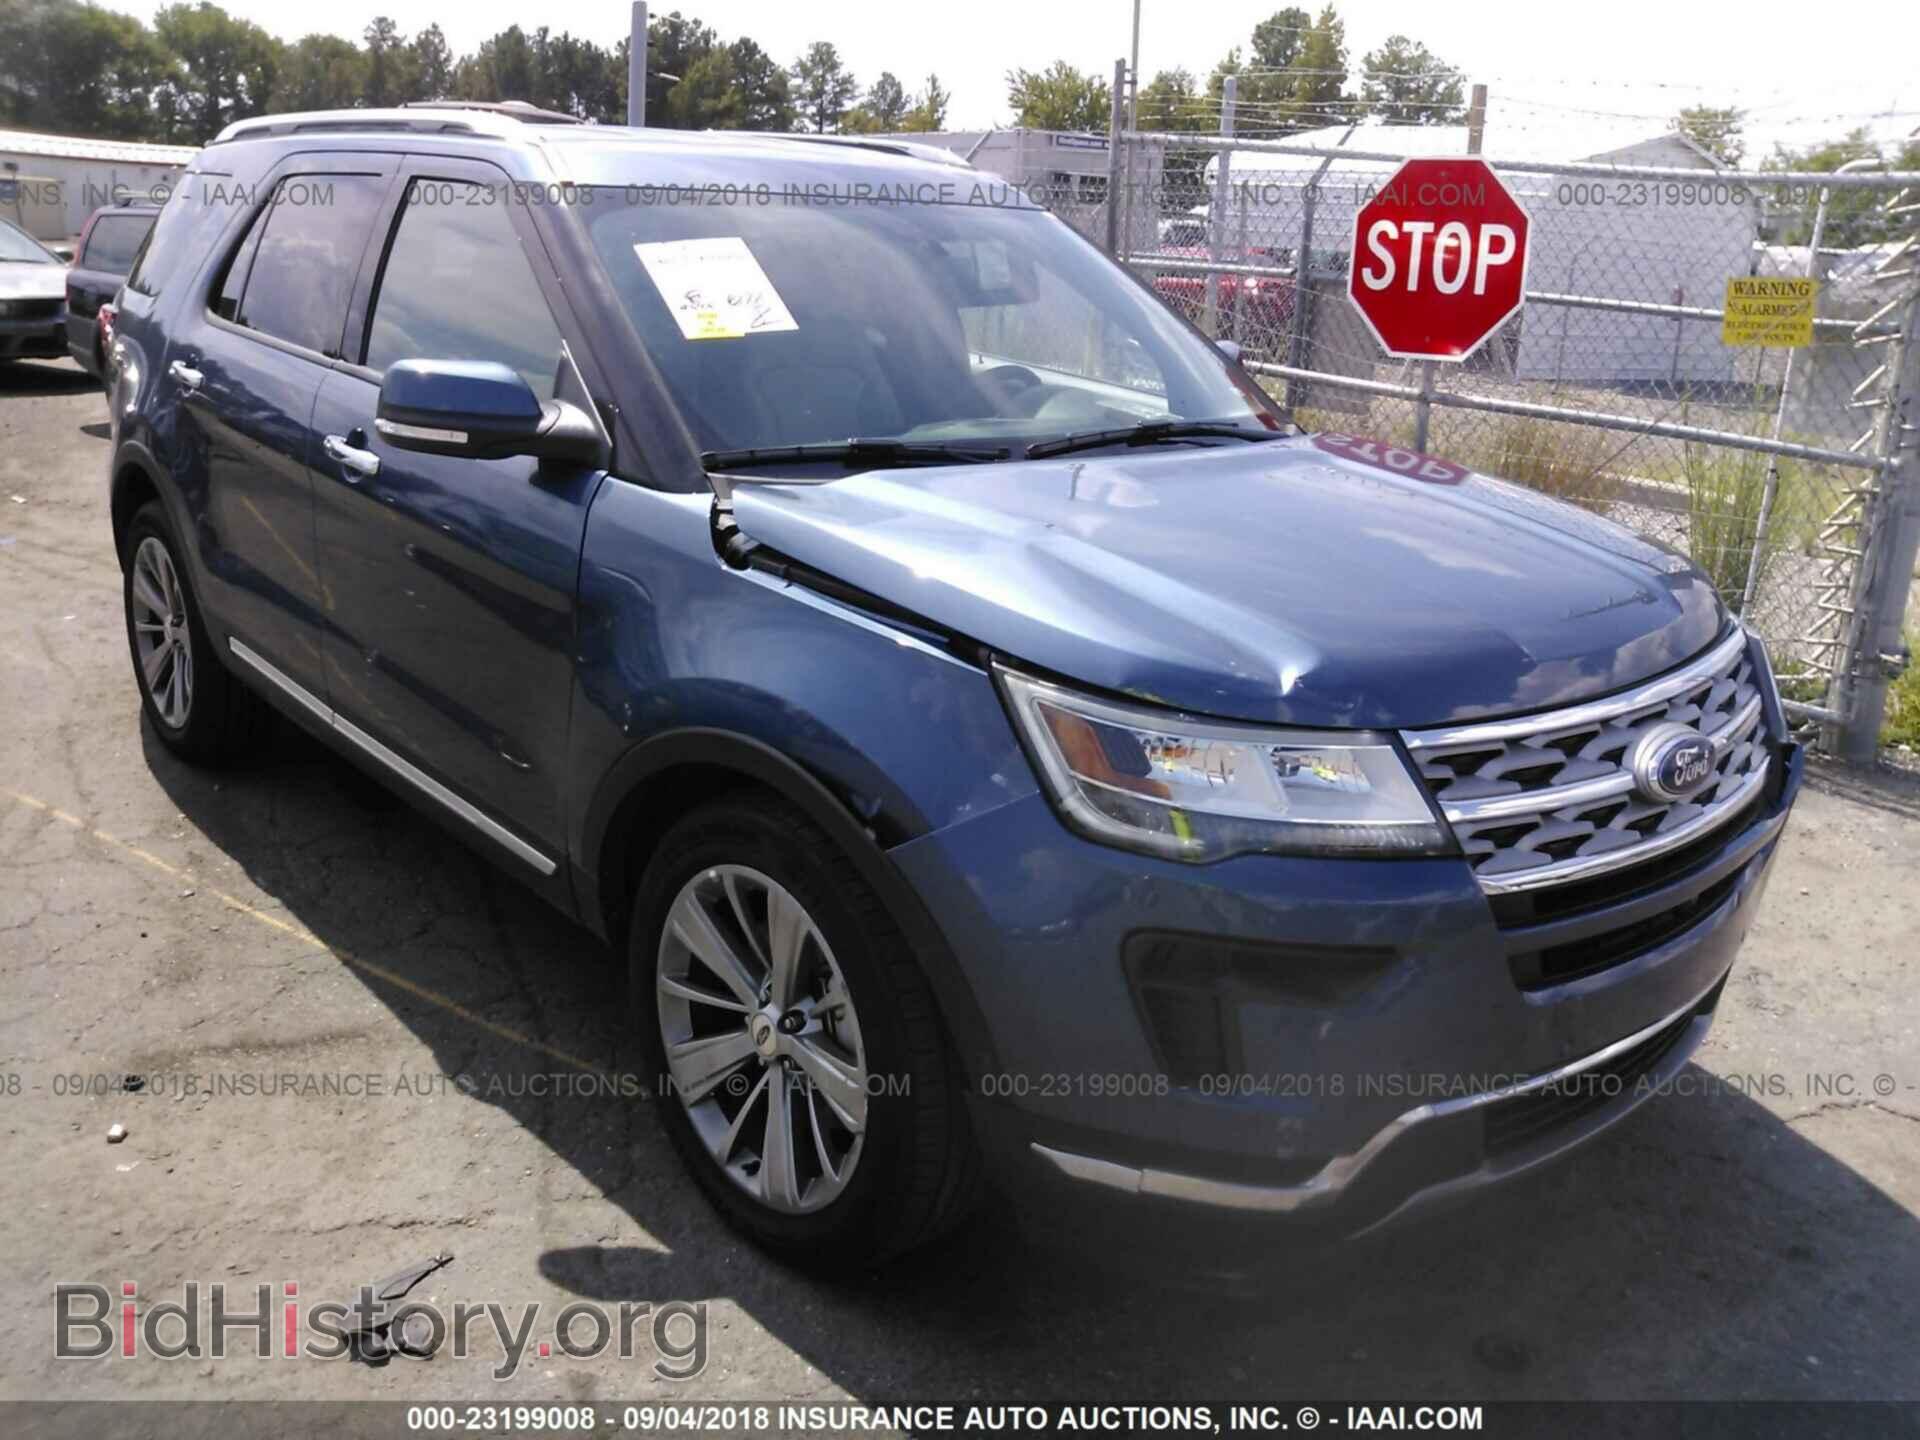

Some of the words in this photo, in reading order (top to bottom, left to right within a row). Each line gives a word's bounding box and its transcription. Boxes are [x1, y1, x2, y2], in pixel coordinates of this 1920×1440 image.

[1361, 219, 1517, 296] STOP
[1734, 281, 1810, 296] WARNING
[1674, 746, 1709, 786] Ford
